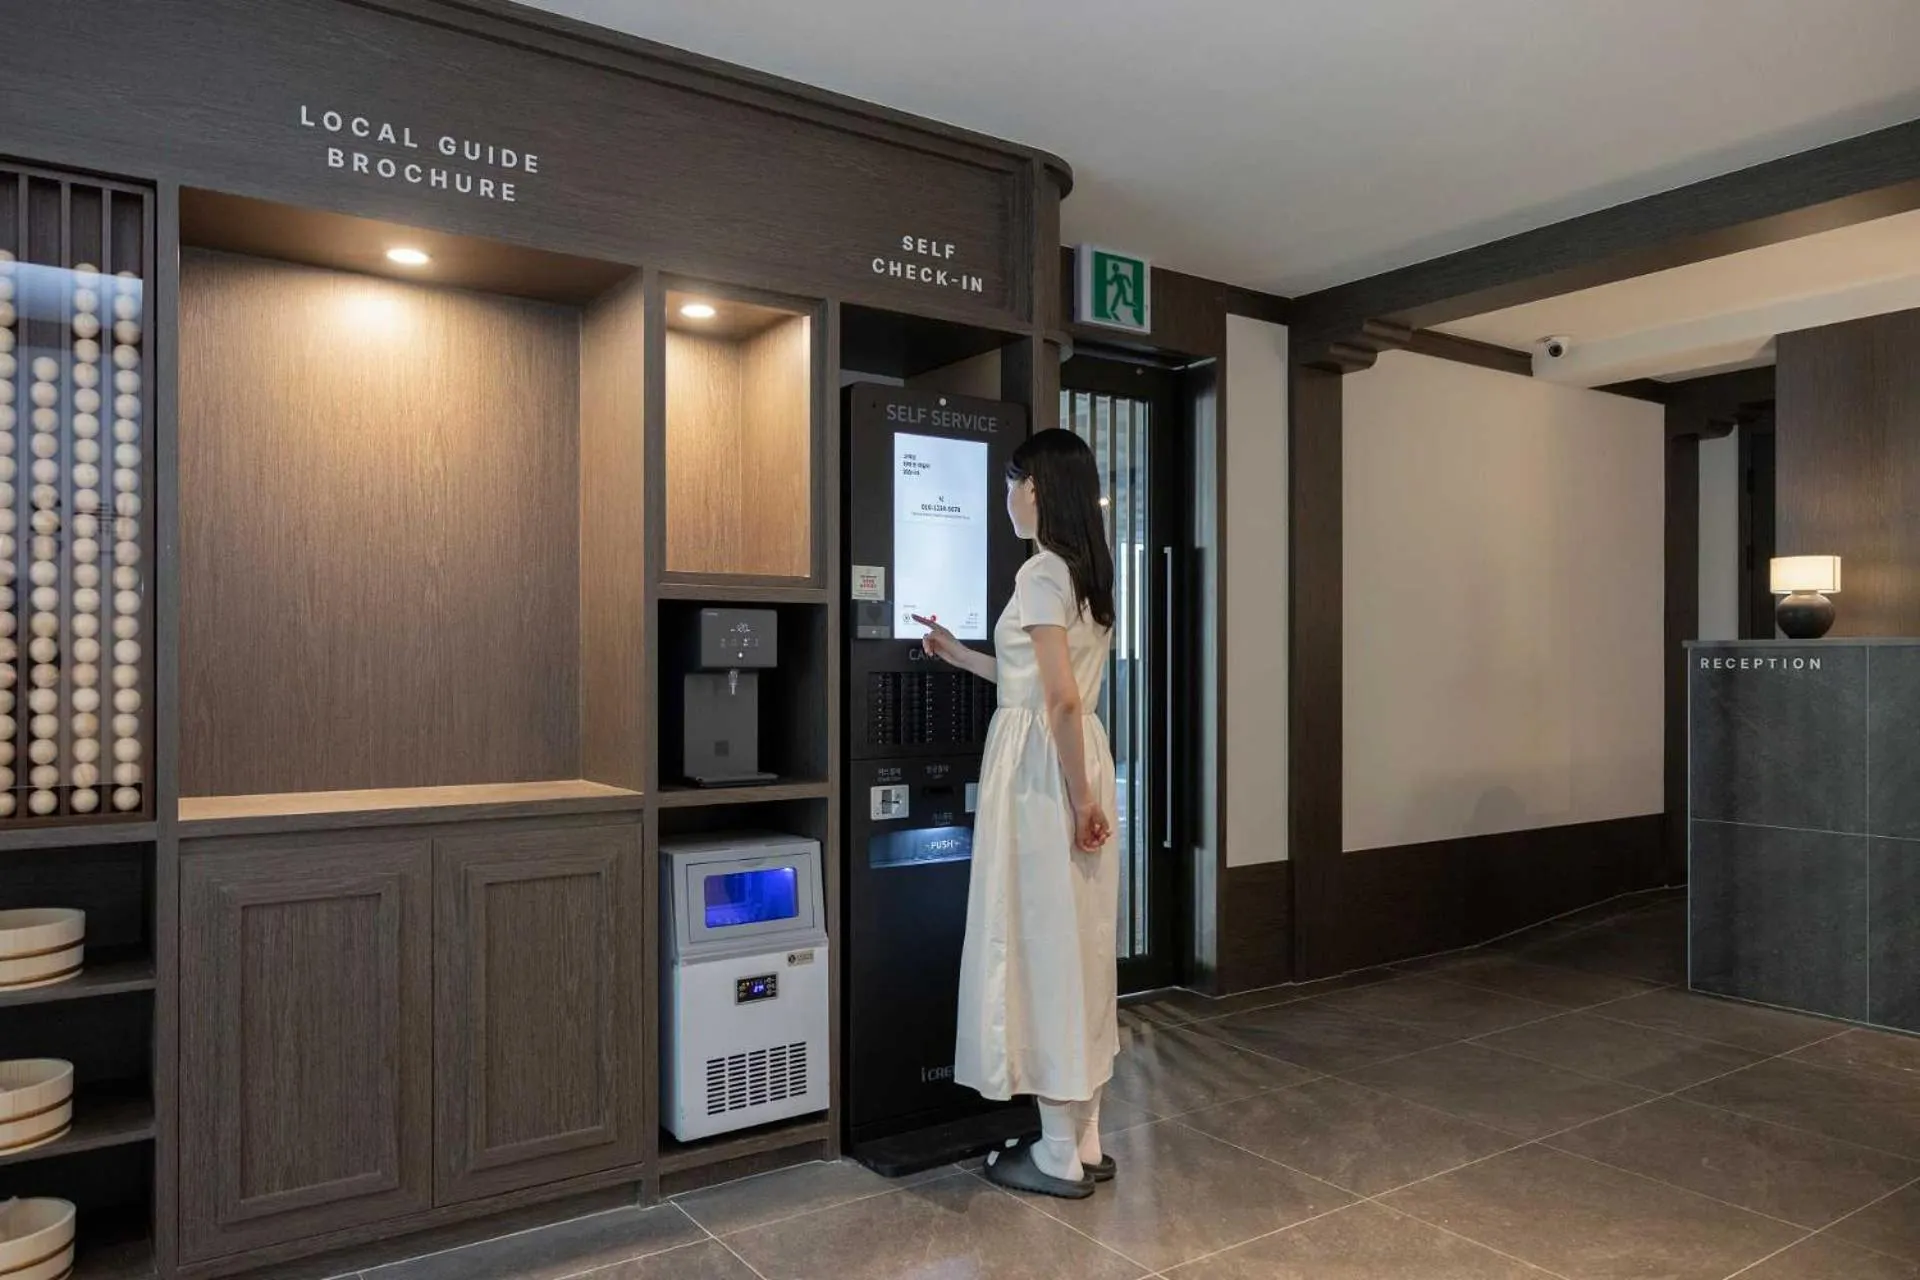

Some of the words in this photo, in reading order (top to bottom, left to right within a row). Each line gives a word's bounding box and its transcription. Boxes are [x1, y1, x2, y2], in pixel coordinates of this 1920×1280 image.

[301, 105, 418, 149] LOCAL
[438, 136, 538, 174] GUIDE
[328, 147, 516, 202] BROCHURE
[902, 235, 955, 259] SELF
[872, 257, 983, 293] CHECK-IN
[886, 403, 927, 424] SELF
[931, 410, 999, 433] SERVICE
[1700, 657, 1821, 670] RECEPTION
